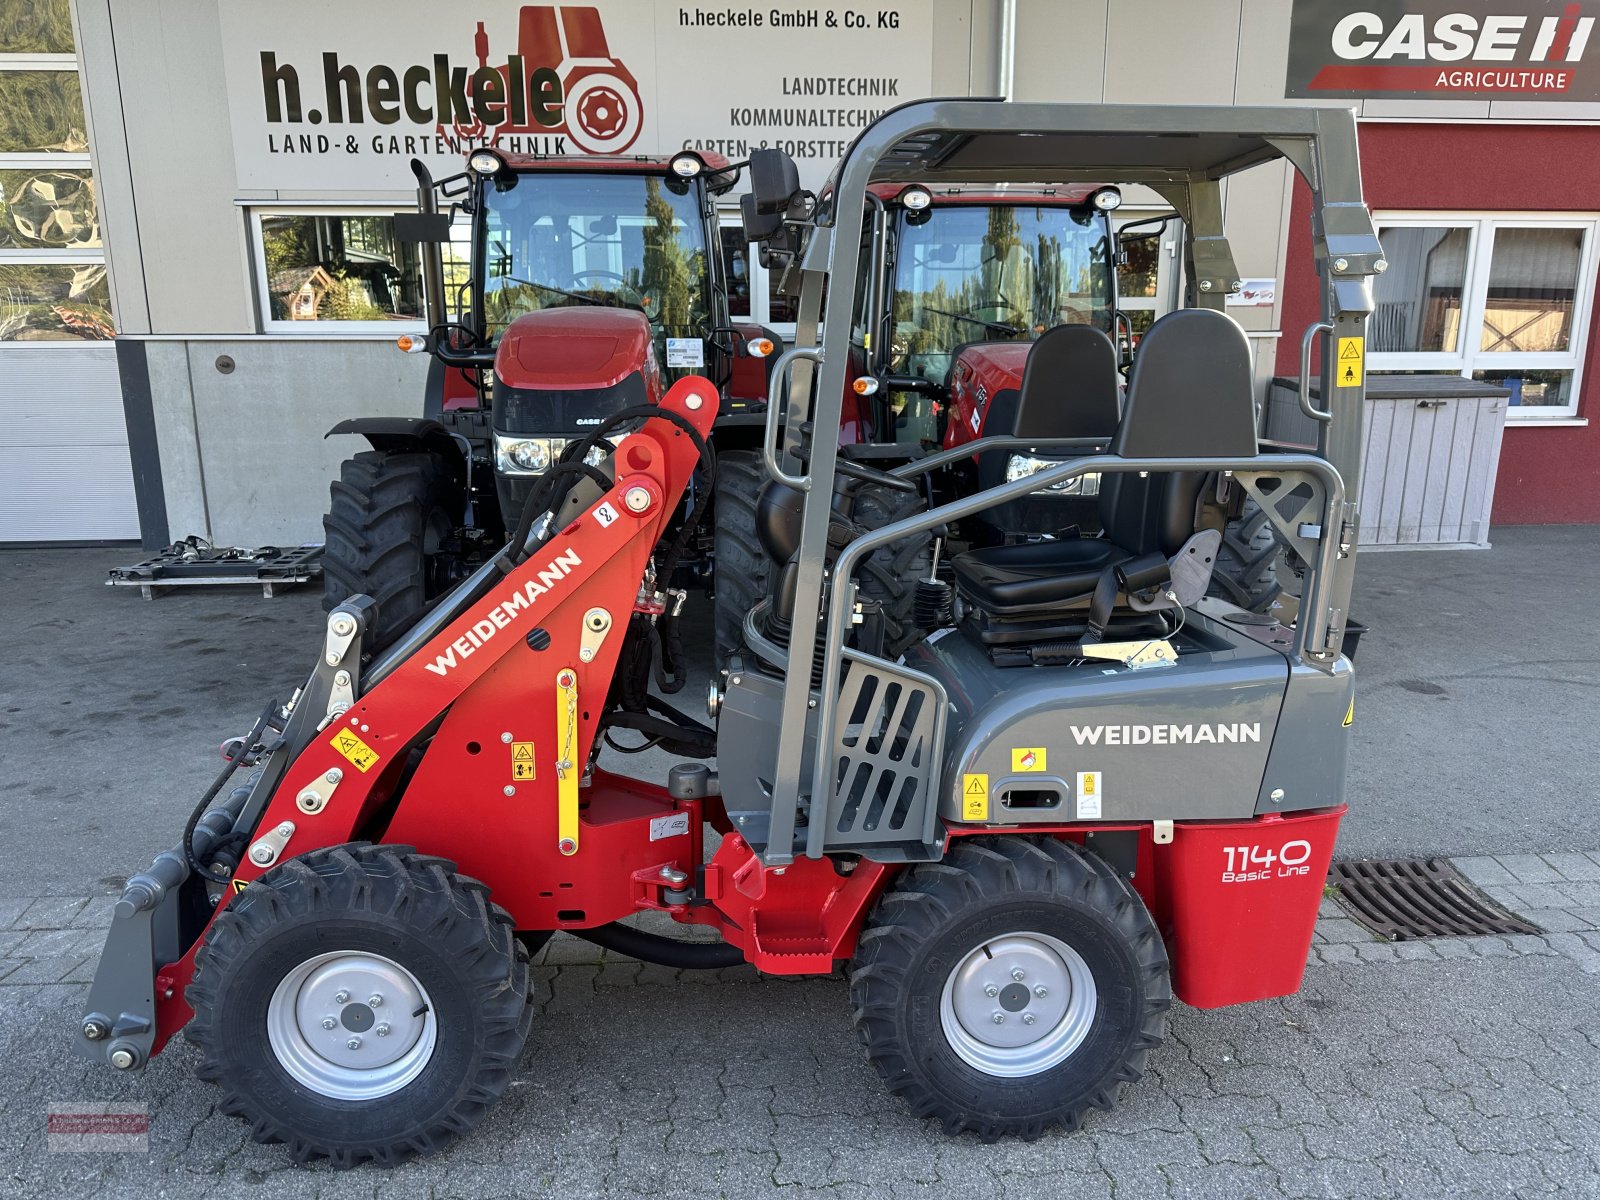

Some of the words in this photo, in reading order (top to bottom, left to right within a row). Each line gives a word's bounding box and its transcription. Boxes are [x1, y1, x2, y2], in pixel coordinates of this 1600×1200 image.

[679, 8, 763, 27] h.heckele
[769, 9, 818, 28] GmbH
[824, 10, 839, 28] &
[844, 10, 871, 29] Co.
[877, 11, 900, 29] KG
[1331, 11, 1527, 62] CASE
[259, 50, 564, 127] h.heckele
[782, 77, 899, 96] LANDTECHNIK
[1435, 71, 1567, 89] AGRICULTURE
[730, 108, 887, 127] KOMMUNALTECHN
[371, 134, 566, 155] GARTENTECHNIK
[576, 418, 601, 426] CASE
[424, 547, 582, 676] WEIDEMANN
[1070, 722, 1261, 745] WEIDEMANN
[1223, 840, 1312, 872] 1140
[1222, 870, 1271, 882] Basic
[1278, 866, 1310, 877] Line
